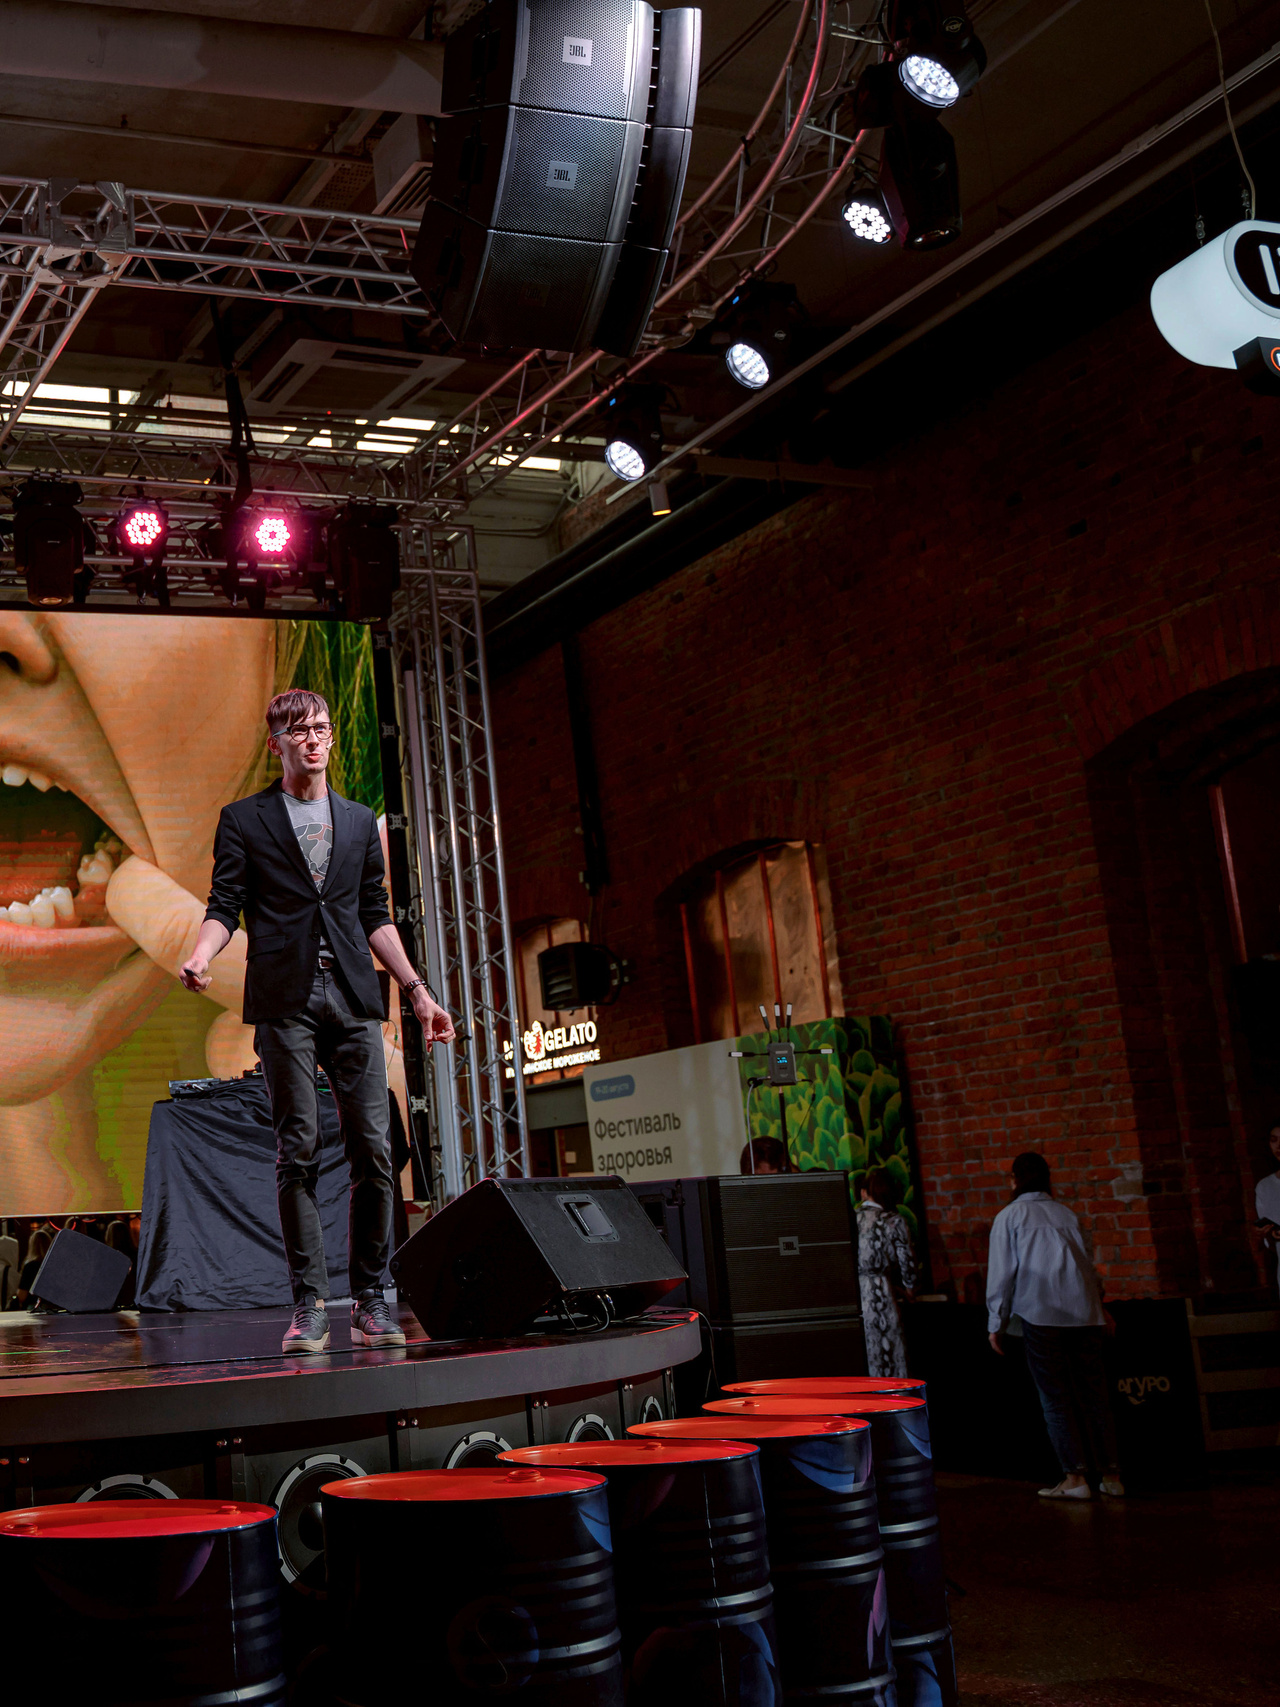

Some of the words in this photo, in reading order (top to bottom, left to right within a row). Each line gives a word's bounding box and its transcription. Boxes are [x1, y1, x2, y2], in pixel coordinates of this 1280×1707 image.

[569, 44, 587, 58] JBL
[553, 168, 571, 182] JBL
[544, 1021, 598, 1052] GELATO
[594, 1111, 682, 1141] Фестиваль
[597, 1146, 673, 1175] здоровья
